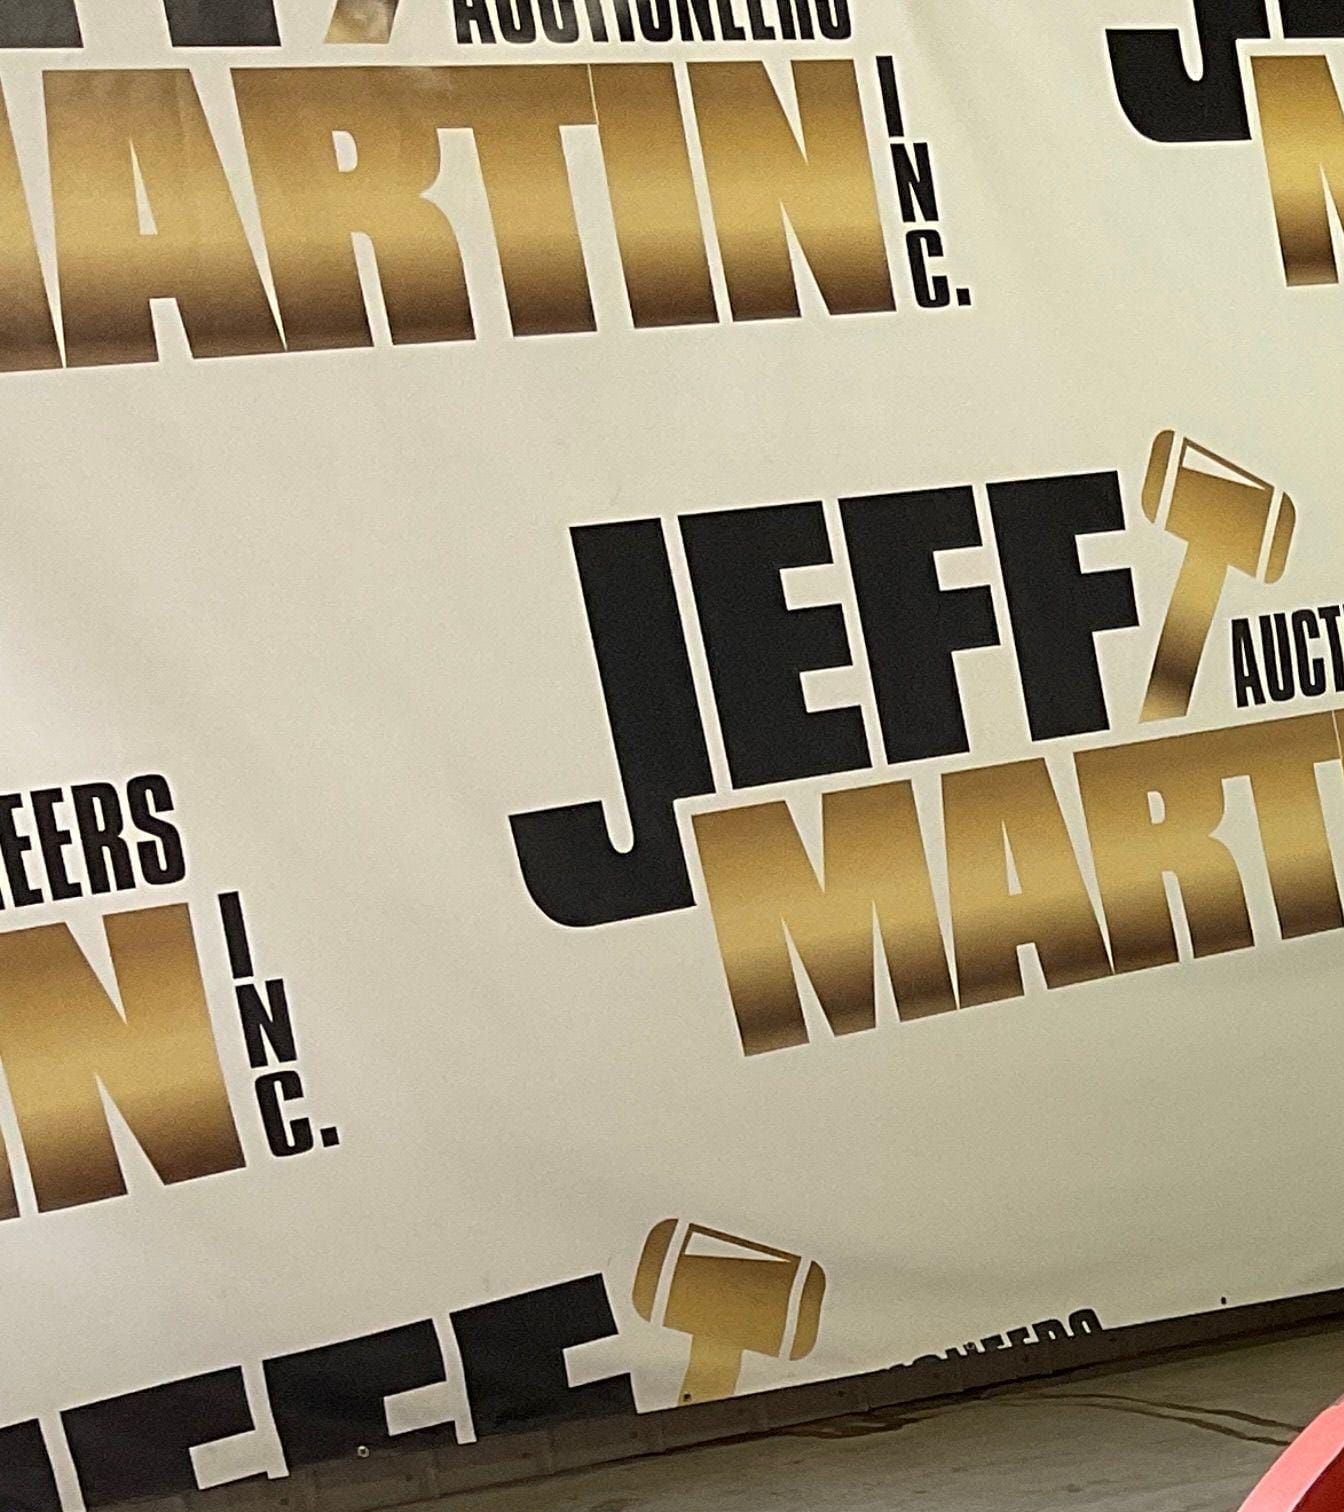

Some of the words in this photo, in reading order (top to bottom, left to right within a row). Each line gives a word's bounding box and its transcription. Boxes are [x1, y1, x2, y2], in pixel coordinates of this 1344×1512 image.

[0, 59, 896, 372] ARTIN
[876, 56, 971, 310] INC.
[509, 471, 1138, 928] JEFF
[0, 774, 186, 910] EERS
[217, 891, 340, 1157] INC.
